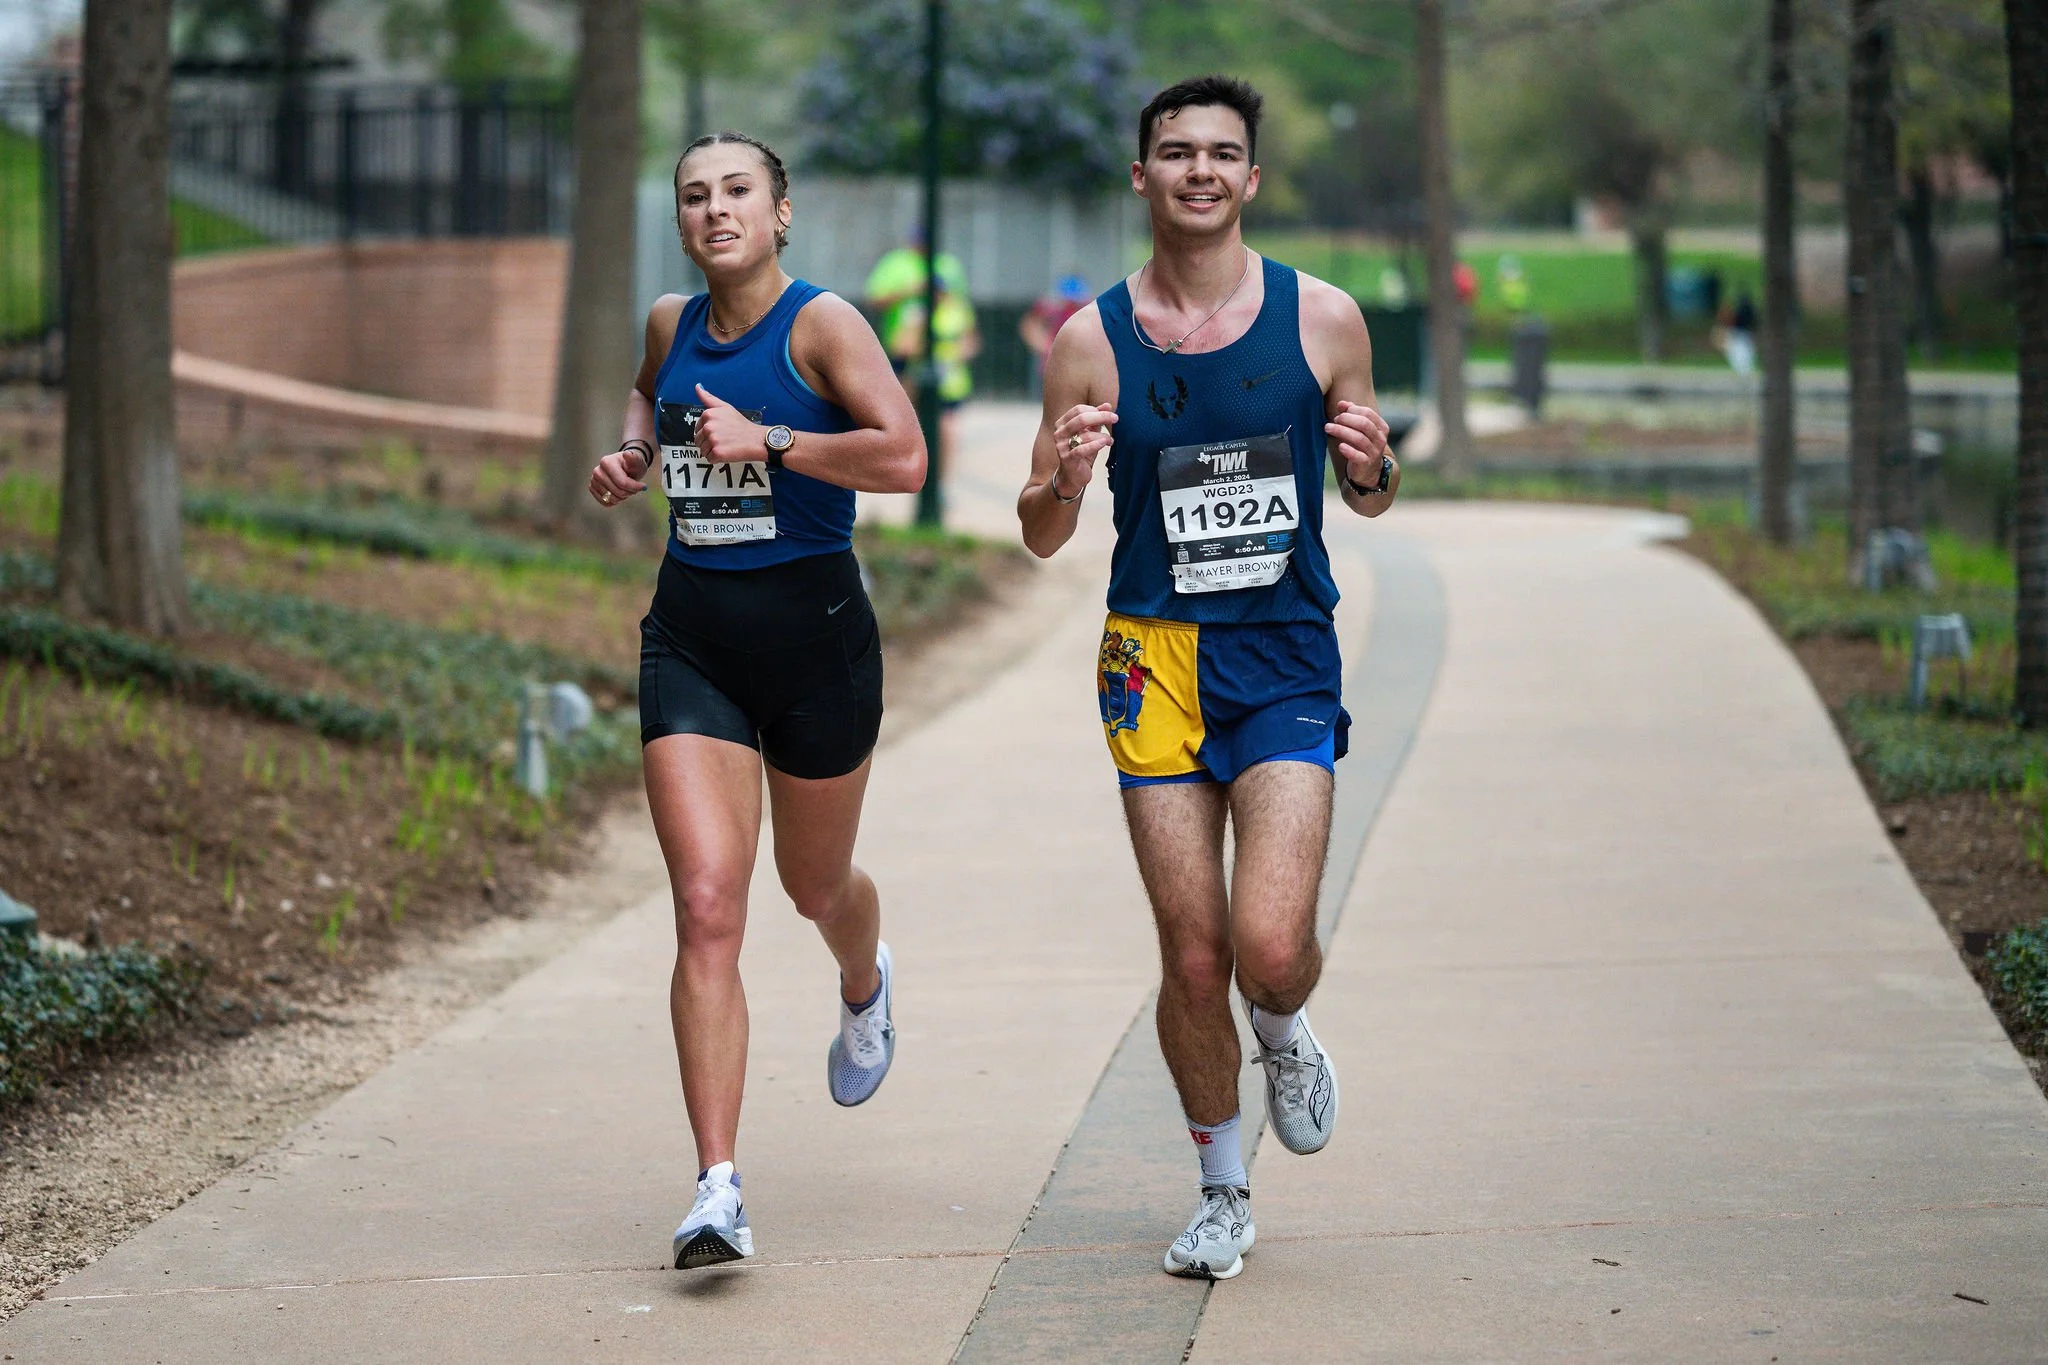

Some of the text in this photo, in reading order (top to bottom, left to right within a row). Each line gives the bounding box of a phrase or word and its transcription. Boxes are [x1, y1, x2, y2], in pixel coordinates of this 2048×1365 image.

[1203, 441, 1248, 452] LEGACY CAPITAL
[671, 449, 703, 459] EMM
[662, 462, 767, 490] 1171A
[1202, 473, 1251, 485] March 2, 2024
[1202, 483, 1254, 499] WGD23
[1169, 494, 1295, 534] 1192A
[682, 522, 754, 535] AYER BROWN
[1252, 544, 1266, 552] AM
[1195, 564, 1233, 578] MAYER
[1238, 559, 1281, 574] BROWN
